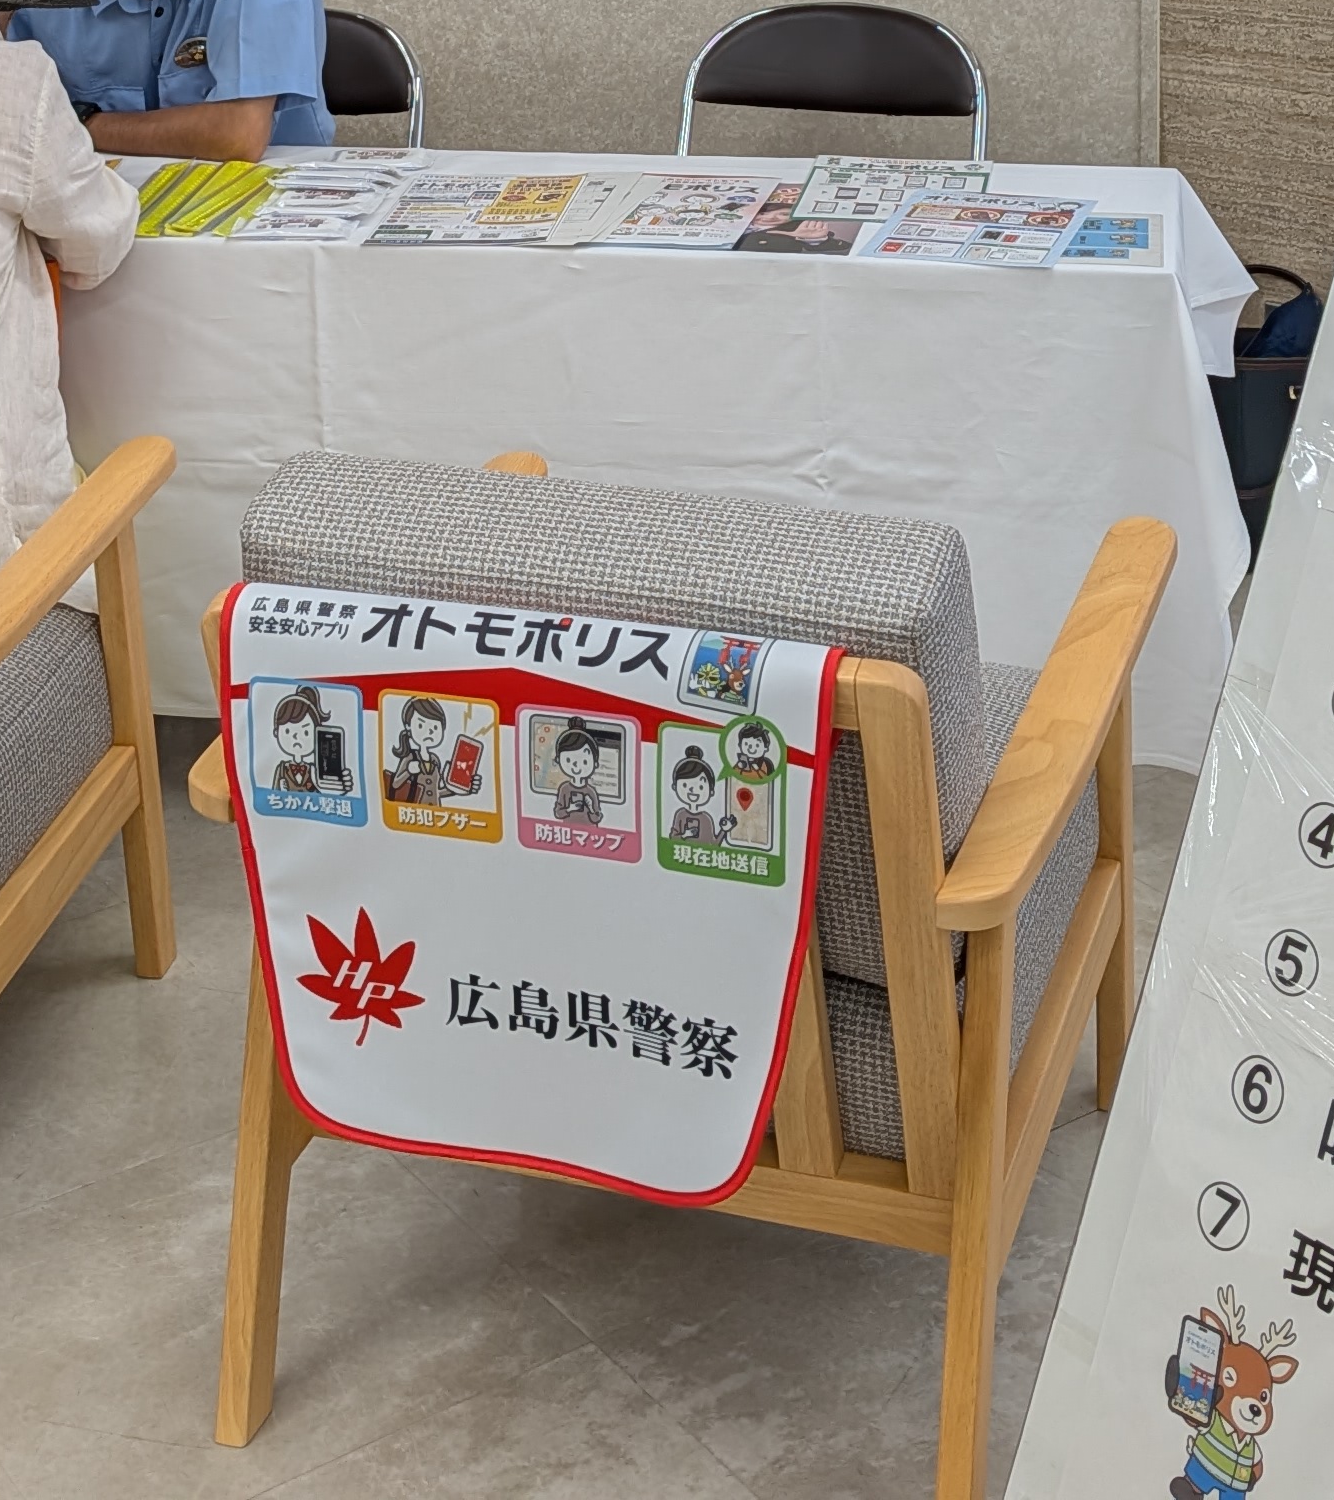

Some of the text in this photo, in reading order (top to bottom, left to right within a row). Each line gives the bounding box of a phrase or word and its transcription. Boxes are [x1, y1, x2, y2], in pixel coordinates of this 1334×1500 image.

[250, 596, 359, 620] 広島県警察
[248, 615, 351, 641] 安全安心アプリ
[360, 603, 670, 681] オトモポリス
[266, 793, 354, 819] ちかん撃退
[398, 805, 488, 832] 防犯ブザー
[534, 822, 626, 852] 防犯マップ
[673, 844, 771, 877] 現在地送信
[446, 974, 740, 1081] 広島県警察
